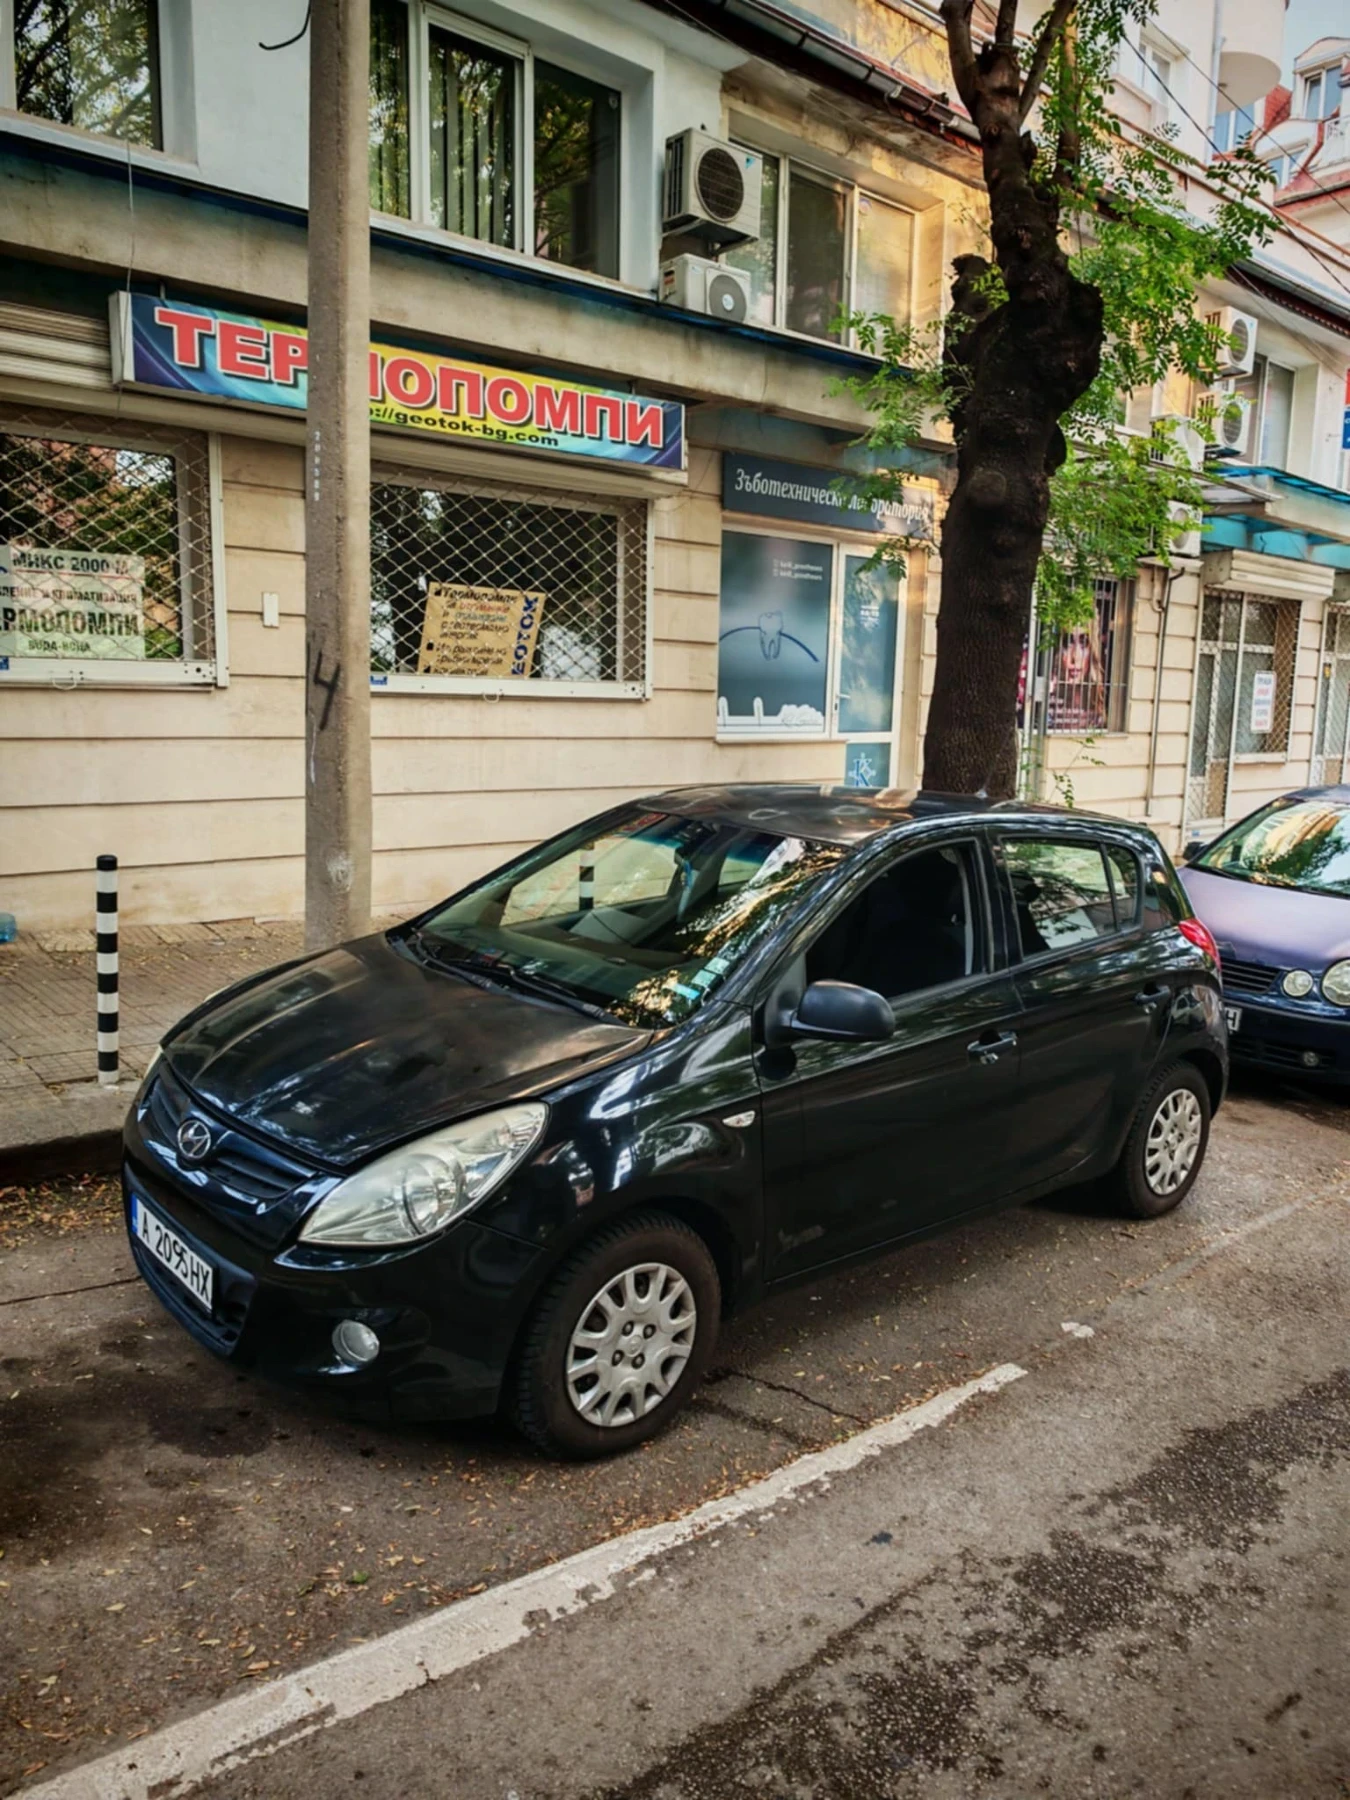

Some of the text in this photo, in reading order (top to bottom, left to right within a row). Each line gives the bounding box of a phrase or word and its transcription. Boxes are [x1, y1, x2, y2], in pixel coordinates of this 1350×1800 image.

[154, 306, 664, 449] ТЕРОПОМПИ
[369, 406, 560, 447] ://geotok-bg.com
[734, 467, 847, 508] Зъботехническ
[0, 606, 141, 637] РМОПОМПИ
